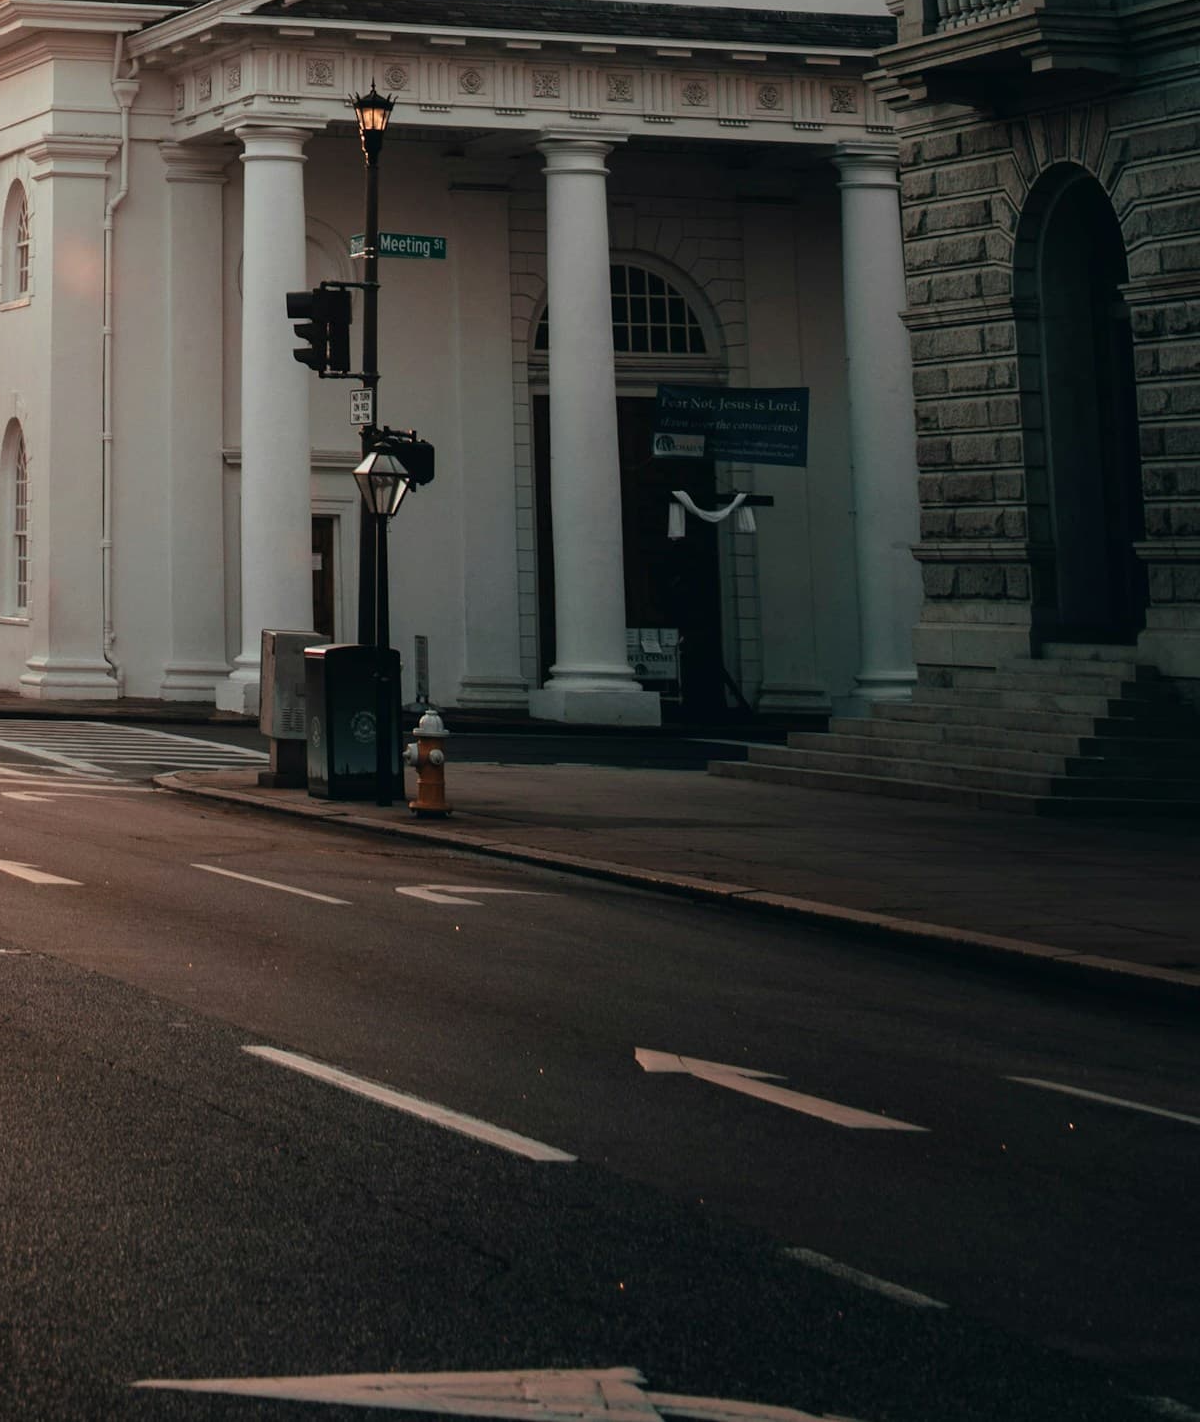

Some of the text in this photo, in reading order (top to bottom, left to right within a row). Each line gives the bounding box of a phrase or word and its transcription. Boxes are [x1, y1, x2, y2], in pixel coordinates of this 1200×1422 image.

[380, 234, 444, 257] Meeting St
[352, 392, 370, 401] NO TURN
[719, 397, 751, 411] Jesus
[754, 398, 765, 410] is
[768, 399, 801, 412] Lord.
